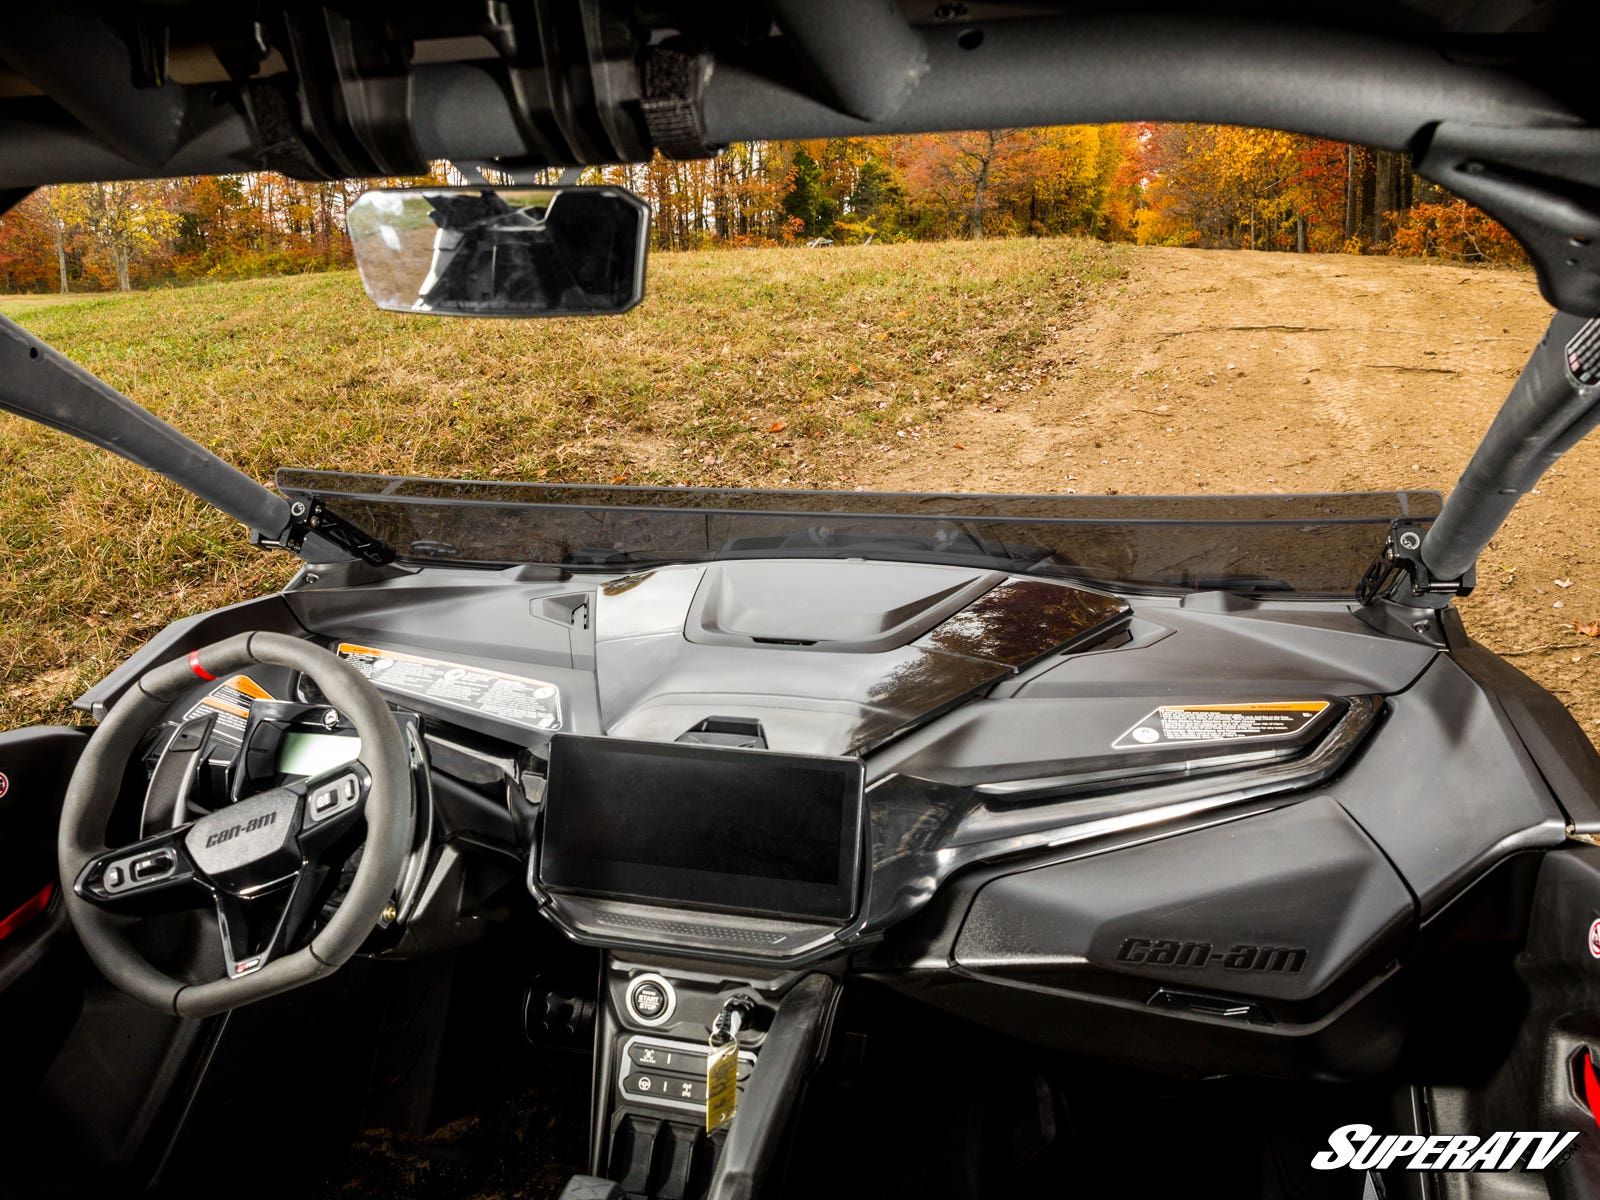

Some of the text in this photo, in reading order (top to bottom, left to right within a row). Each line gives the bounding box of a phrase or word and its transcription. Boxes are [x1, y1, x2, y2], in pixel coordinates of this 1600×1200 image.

[205, 810, 277, 849] can-am
[1116, 937, 1309, 974] can-am
[638, 994, 659, 1003] START
[639, 1002, 657, 1010] STOP
